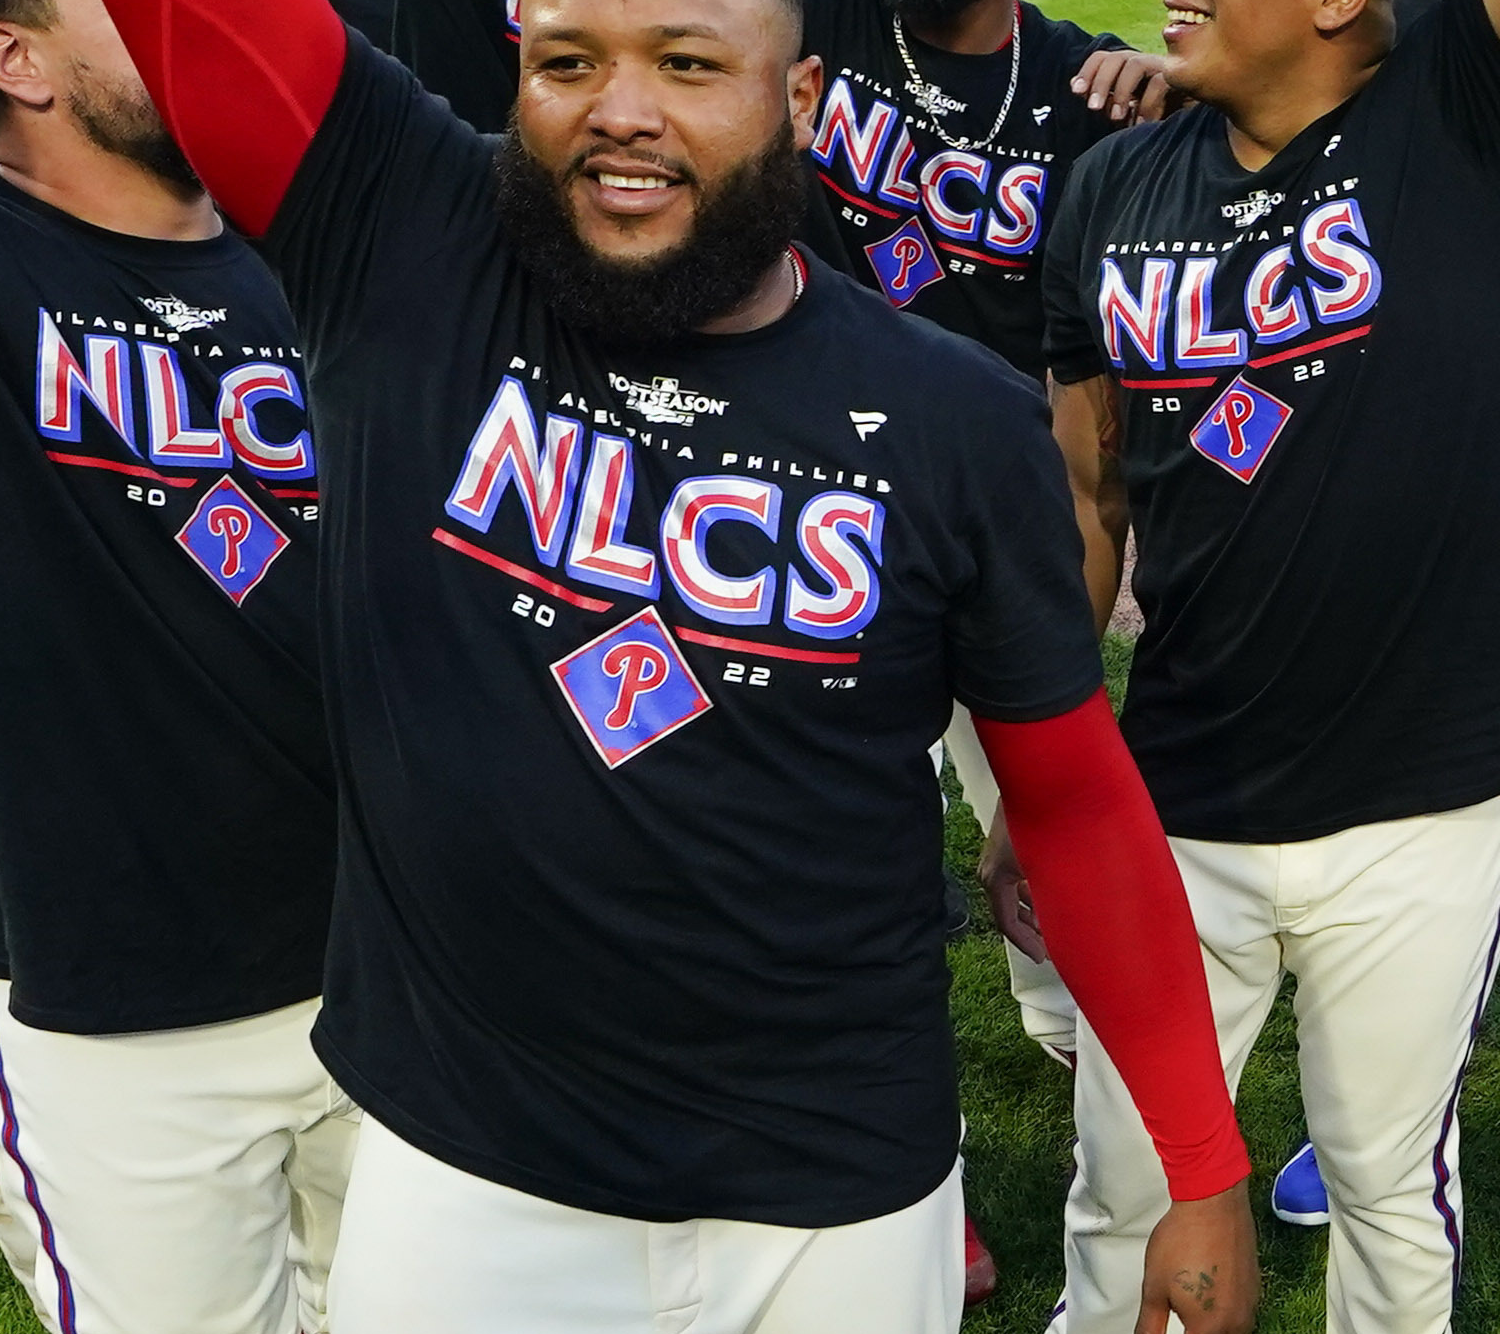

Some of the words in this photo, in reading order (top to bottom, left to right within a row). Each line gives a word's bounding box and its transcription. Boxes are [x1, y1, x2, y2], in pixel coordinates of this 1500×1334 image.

[810, 77, 1049, 255] NLCS
[841, 206, 868, 228] 20
[948, 259, 977, 276] 22
[890, 236, 924, 290] P
[1100, 197, 1382, 371] NLCS
[1151, 397, 1181, 413] 20
[1293, 359, 1326, 381] 22
[1211, 389, 1255, 459] P
[126, 484, 167, 508] 20
[443, 372, 888, 641] NLCS
[721, 452, 892, 495] PHILLIES
[207, 504, 253, 580] P
[511, 592, 557, 629] 20
[721, 662, 772, 688] 22
[601, 639, 670, 731] P
